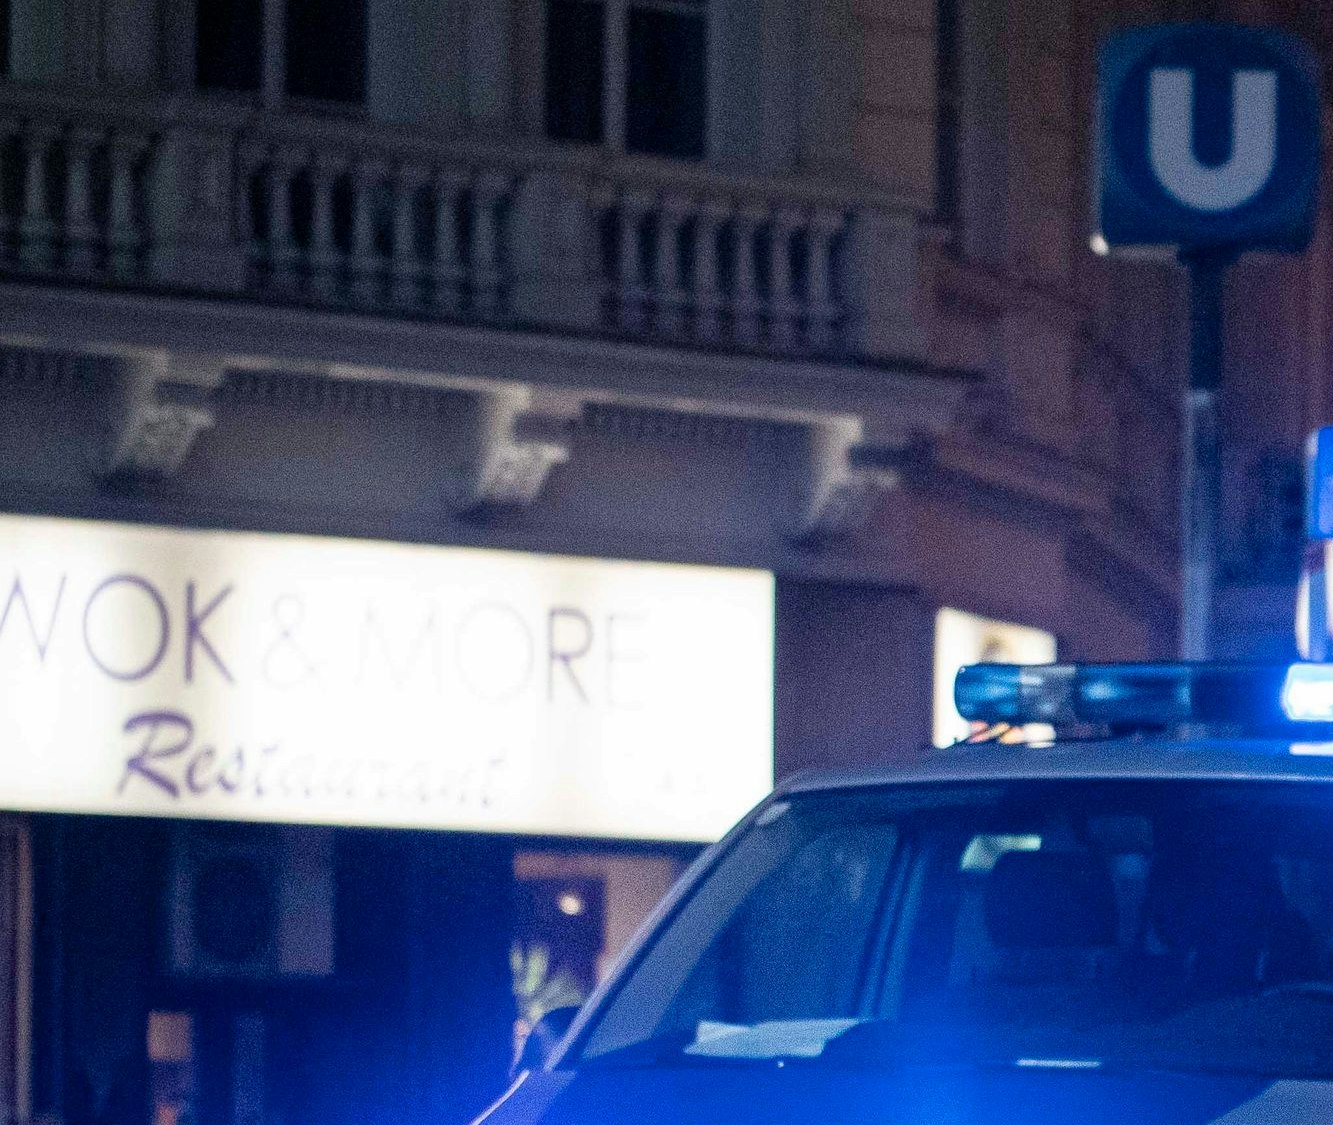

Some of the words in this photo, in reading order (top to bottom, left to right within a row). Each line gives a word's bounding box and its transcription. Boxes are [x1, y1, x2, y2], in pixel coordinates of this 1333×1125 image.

[1149, 68, 1277, 212] U
[354, 597, 648, 709] MORE
[117, 706, 506, 809] Restaurant
